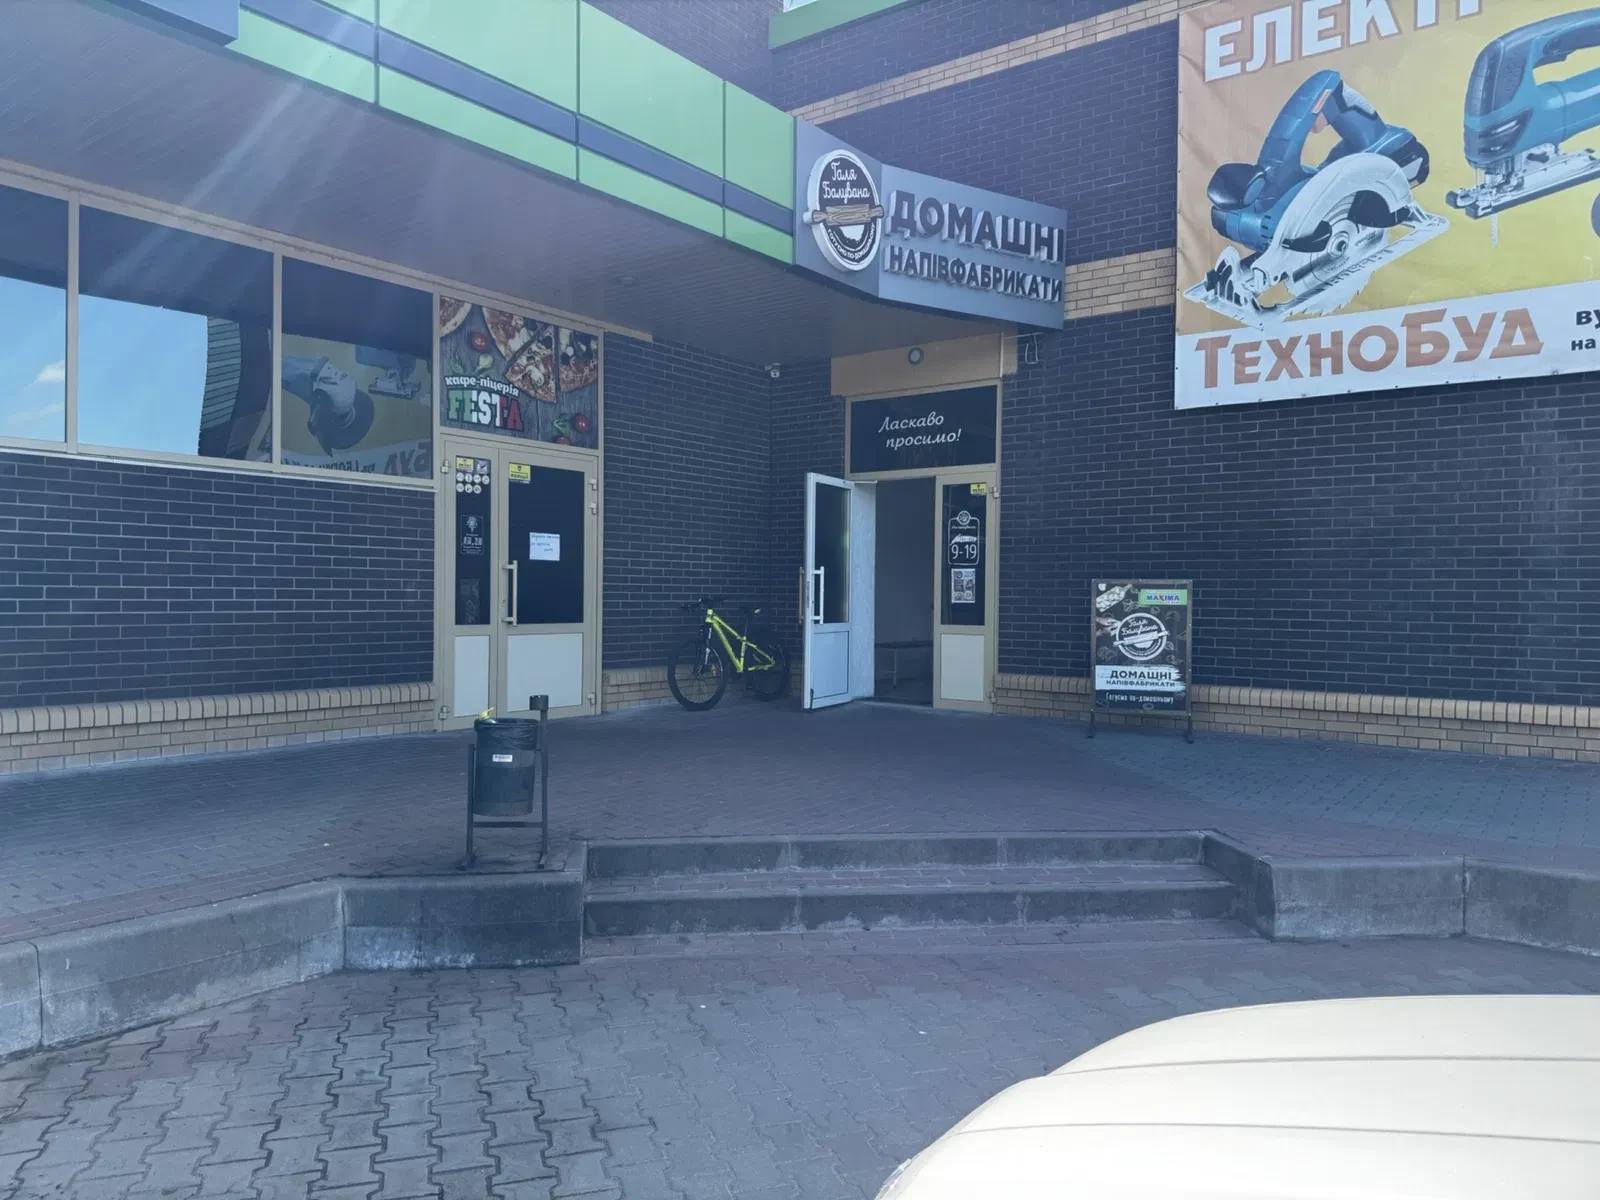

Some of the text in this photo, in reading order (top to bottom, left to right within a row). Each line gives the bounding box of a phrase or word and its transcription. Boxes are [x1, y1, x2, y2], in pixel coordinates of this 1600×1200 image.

[831, 162, 857, 181] Галя
[822, 181, 870, 204] Балувана
[885, 190, 1064, 264] ДОМАШНІ
[884, 245, 1063, 302] НАПІВФАБРИКАТИ
[1571, 338, 1596, 351] на
[445, 376, 519, 397] кафе-піцерія
[448, 389, 524, 431] FESTA
[877, 411, 944, 433] Ласкаво
[886, 428, 962, 450] просимо!
[951, 544, 977, 560] 9-19
[1146, 594, 1180, 602] MAXIMA
[1110, 670, 1172, 680] ДОМАШНІ
